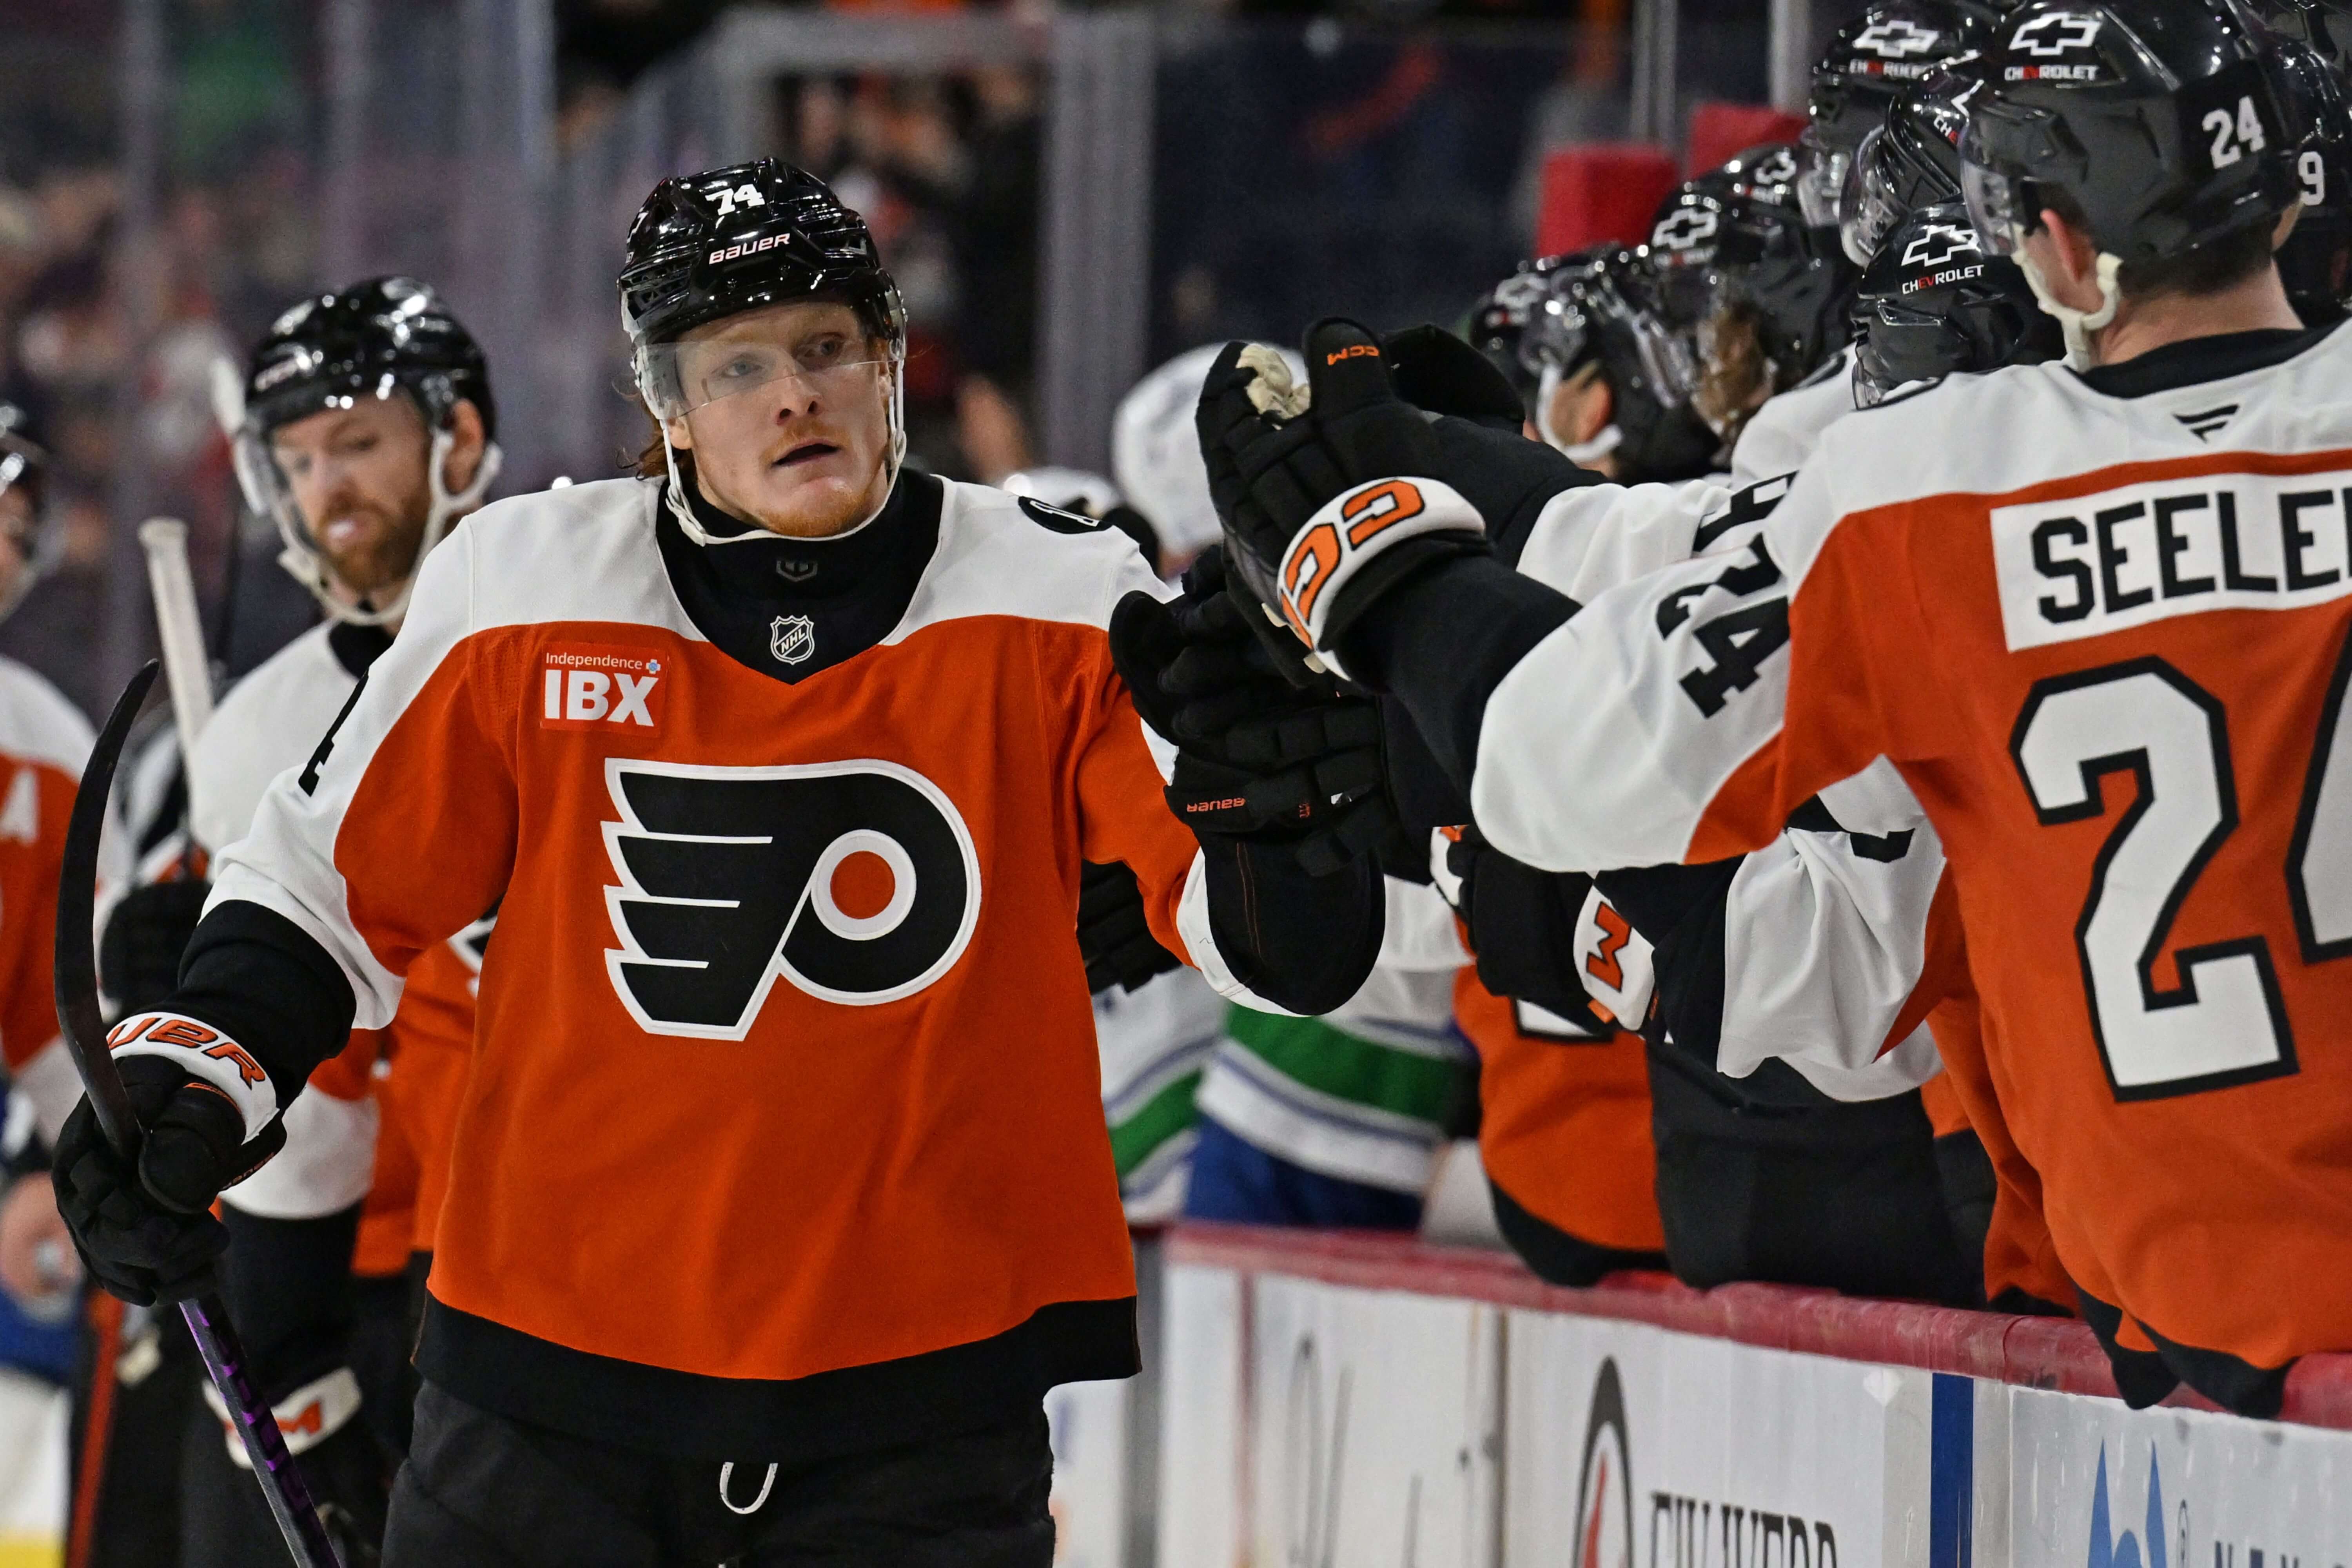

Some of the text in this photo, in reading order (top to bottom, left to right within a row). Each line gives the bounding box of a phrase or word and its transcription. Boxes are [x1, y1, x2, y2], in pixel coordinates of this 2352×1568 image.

[2202, 95, 2266, 169] 24
[706, 184, 765, 216] 74
[709, 233, 791, 265] BAUER
[1902, 265, 1985, 295] CHEVROLET
[1327, 345, 1379, 366] CCM
[2031, 487, 2352, 624] SEELE
[1655, 531, 1790, 718] 24
[781, 628, 806, 654] NHL
[546, 652, 642, 670] Independence
[544, 669, 659, 727] IBX
[1187, 797, 1246, 812] BAUER
[107, 1017, 266, 1090] UER
